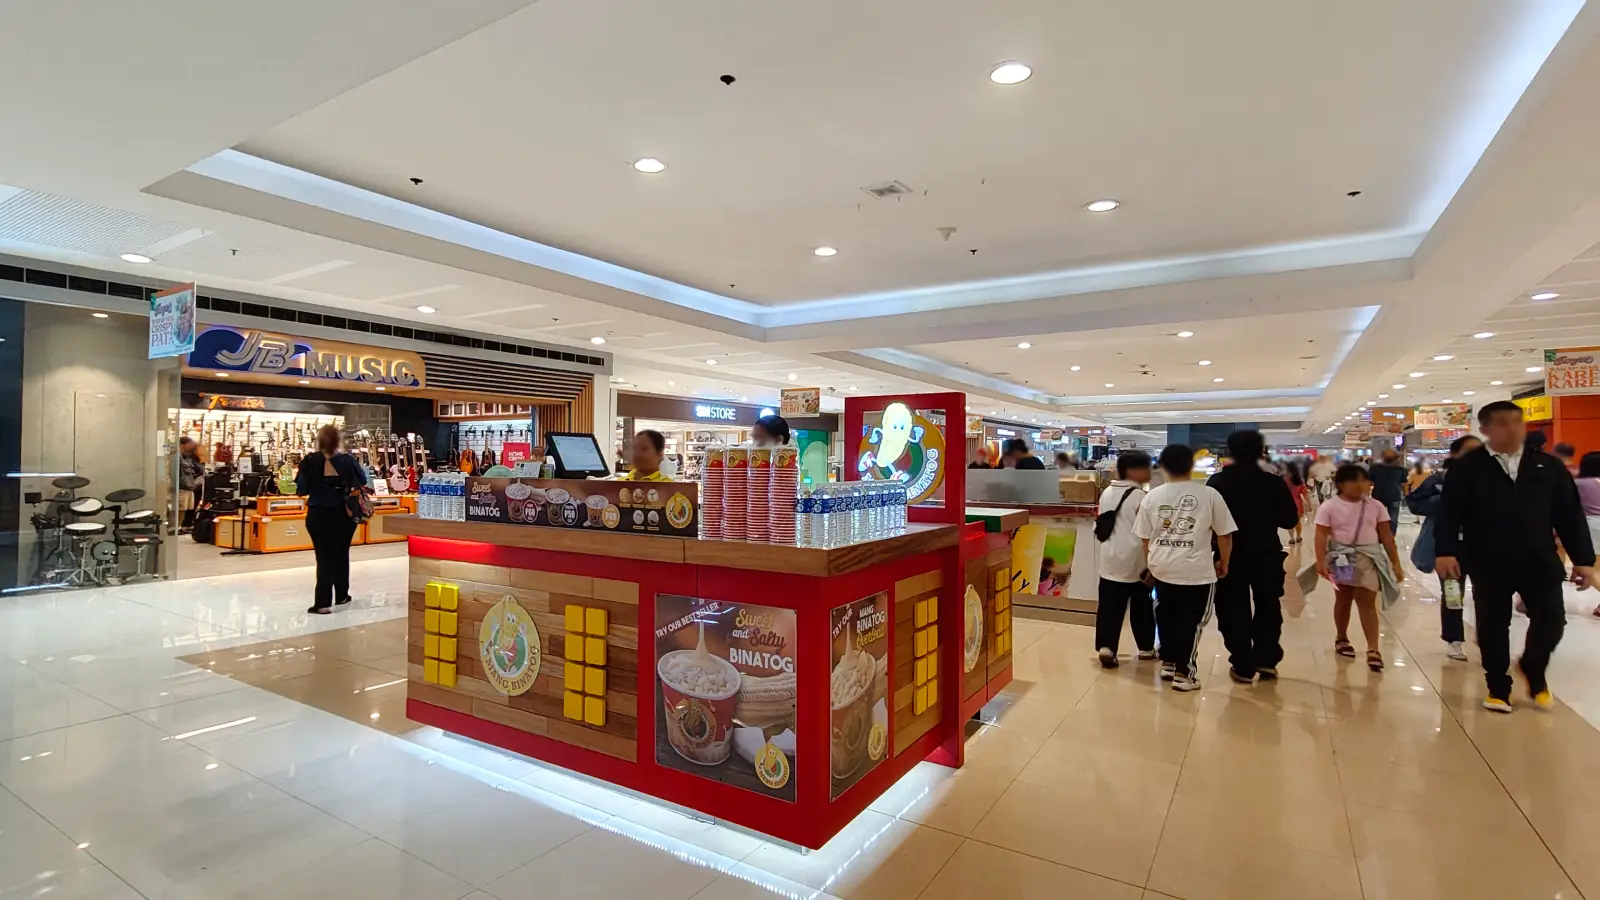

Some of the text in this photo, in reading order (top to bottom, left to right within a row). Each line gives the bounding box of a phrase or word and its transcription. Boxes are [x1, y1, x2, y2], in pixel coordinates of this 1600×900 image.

[215, 331, 420, 386] JB MUSIC
[1547, 378, 1600, 389] KARE
[710, 406, 737, 420] STORE
[906, 448, 939, 500] INATOG
[471, 481, 492, 494] Sweet
[469, 505, 501, 517] BINATOG
[656, 601, 719, 638] TRY OUR BEST SELLER
[735, 608, 772, 630] Sweet
[856, 611, 885, 634] BINATOG
[859, 604, 874, 618] MANG
[833, 608, 853, 639] TRY OUR
[732, 628, 787, 654] and Salty
[486, 645, 540, 691] MANG BINATOG
[729, 647, 794, 673] BINATOG
